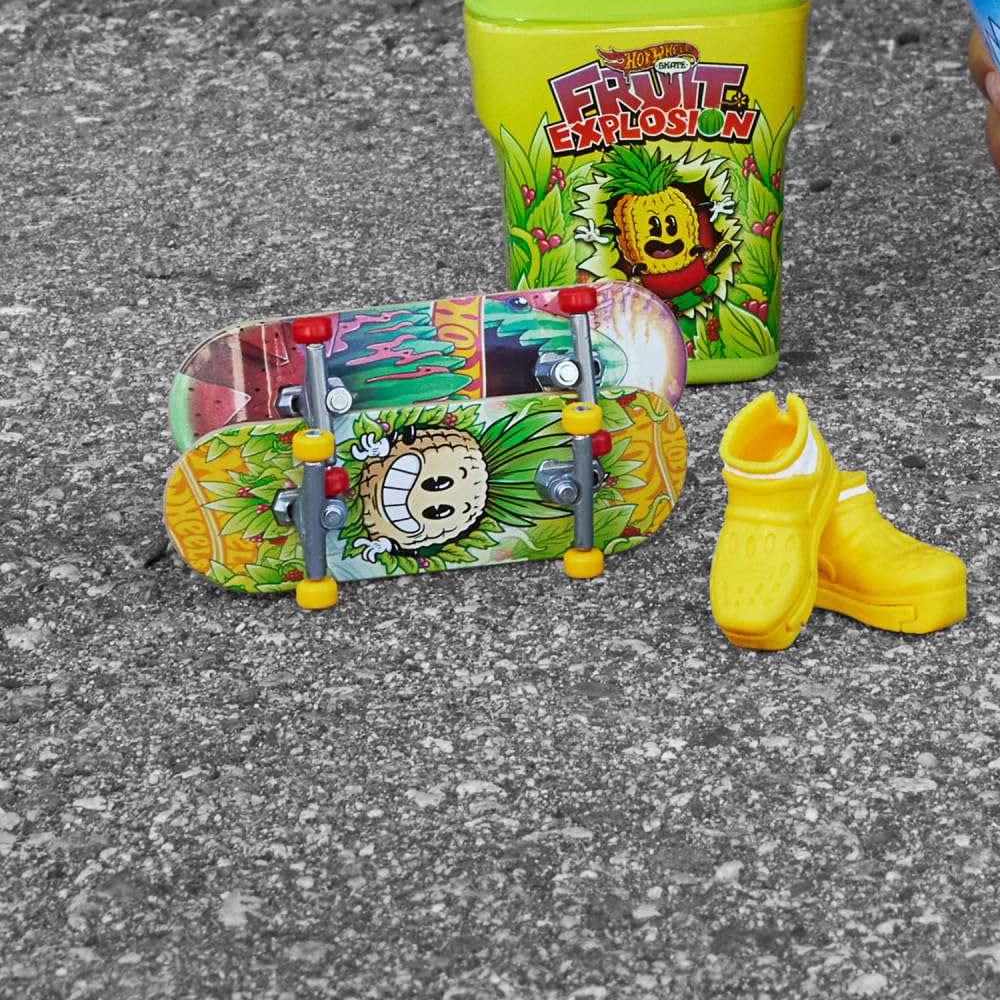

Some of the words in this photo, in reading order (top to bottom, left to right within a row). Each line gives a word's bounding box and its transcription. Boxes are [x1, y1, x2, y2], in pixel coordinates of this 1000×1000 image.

[657, 60, 687, 70] SKATE
[549, 59, 748, 124] FRUIT
[545, 106, 759, 157] EXPLOSION
